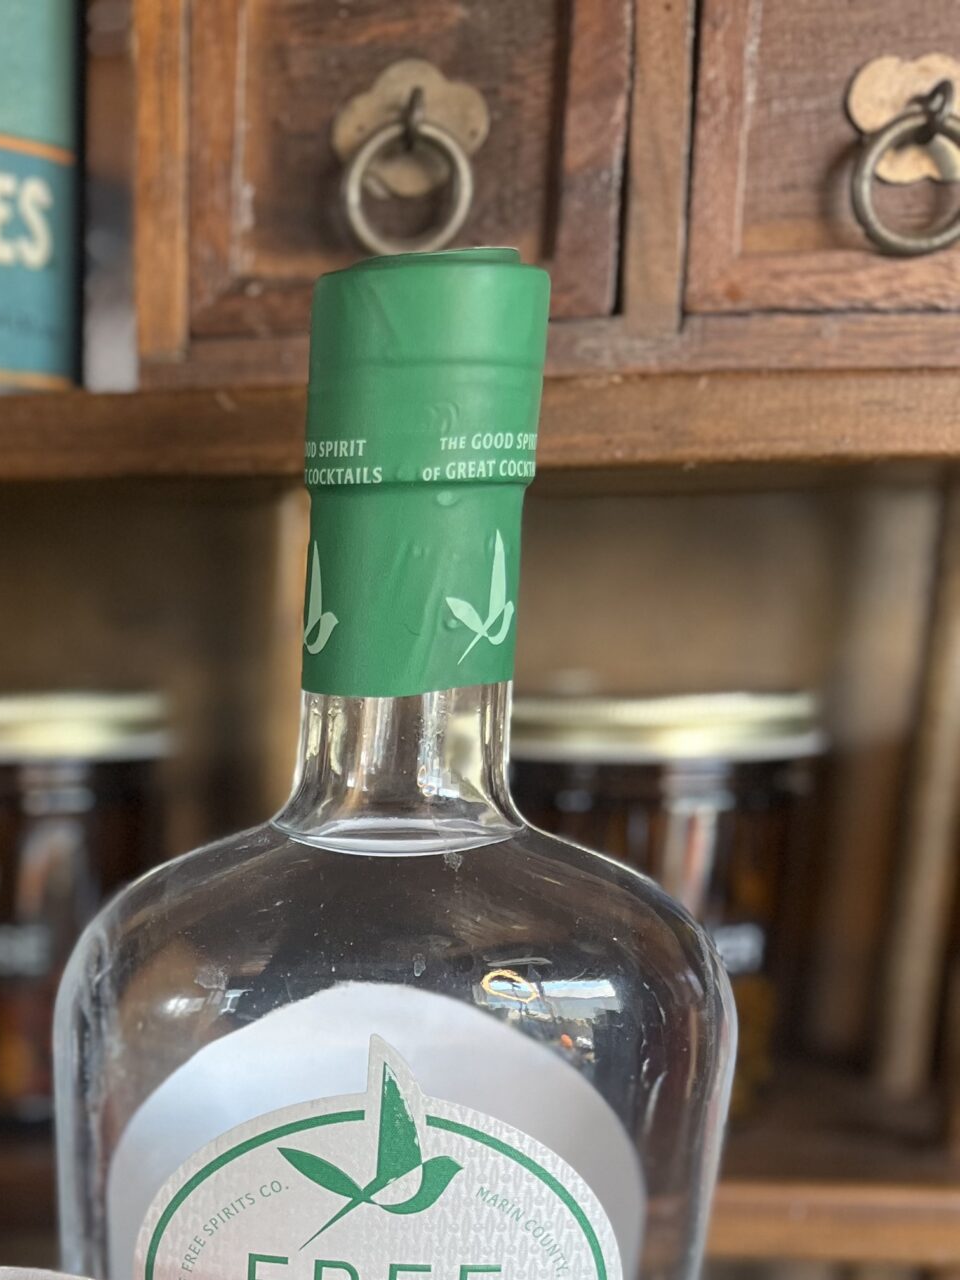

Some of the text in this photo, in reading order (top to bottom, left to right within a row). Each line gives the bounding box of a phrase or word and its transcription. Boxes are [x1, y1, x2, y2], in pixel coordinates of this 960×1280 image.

[319, 439, 367, 457] SPIRIT
[440, 436, 466, 450] THE
[471, 432, 514, 450] GOOD
[308, 466, 383, 485] COCKTAILS
[422, 467, 441, 481] OF
[446, 459, 496, 480] GREAT
[476, 1186, 525, 1222] MARIN
[181, 1235, 207, 1273] FREE
[202, 1193, 256, 1236] SPIRITS
[259, 1180, 289, 1198] CO.
